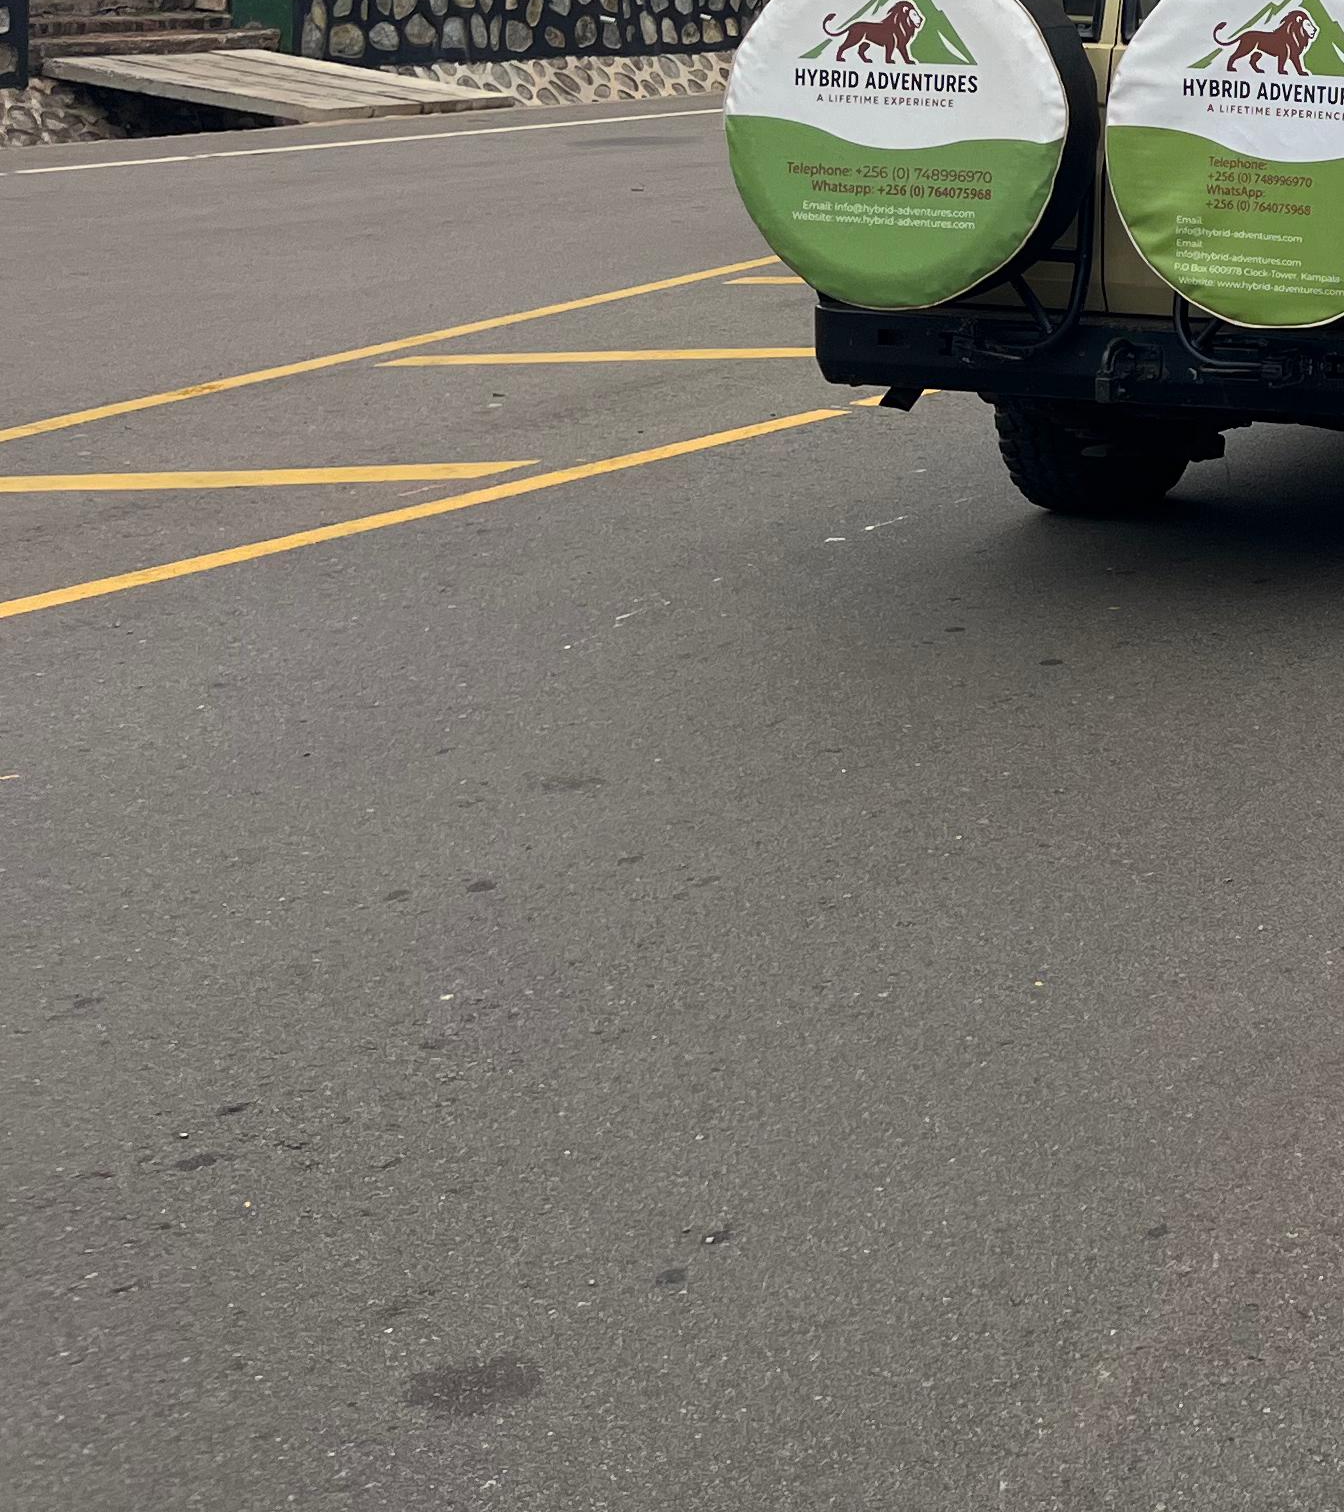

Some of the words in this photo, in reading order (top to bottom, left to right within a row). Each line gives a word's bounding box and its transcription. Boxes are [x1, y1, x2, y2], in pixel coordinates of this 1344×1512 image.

[795, 68, 859, 88] HYBRID
[865, 71, 978, 93] ADVENTURES
[1183, 78, 1250, 100] HYBRID
[816, 94, 824, 102] A
[829, 94, 879, 105] LIFETIME
[884, 96, 954, 108] EXPERIENCE
[1207, 104, 1214, 112] A
[1219, 105, 1271, 116] LIFETIME
[1209, 156, 1268, 171] Telephone:
[787, 161, 853, 178] Telephone:
[855, 165, 888, 179] +256
[892, 167, 910, 181] (0)
[914, 168, 992, 184] 748996970
[1208, 171, 1235, 183] +256
[1237, 173, 1252, 186] (0)
[1254, 174, 1312, 188] 748996970
[811, 180, 874, 196] Whatsapp:
[877, 184, 907, 196] +256
[910, 185, 925, 199] (0)
[927, 186, 992, 200] 764075968
[1205, 200, 1234, 211] +256
[1236, 201, 1251, 213] (0)
[1253, 202, 1312, 216] 764075968
[836, 214, 976, 229] www.hybrid-adventures.com
[1191, 263, 1208, 274] Box
[1208, 264, 1242, 276] 600978
